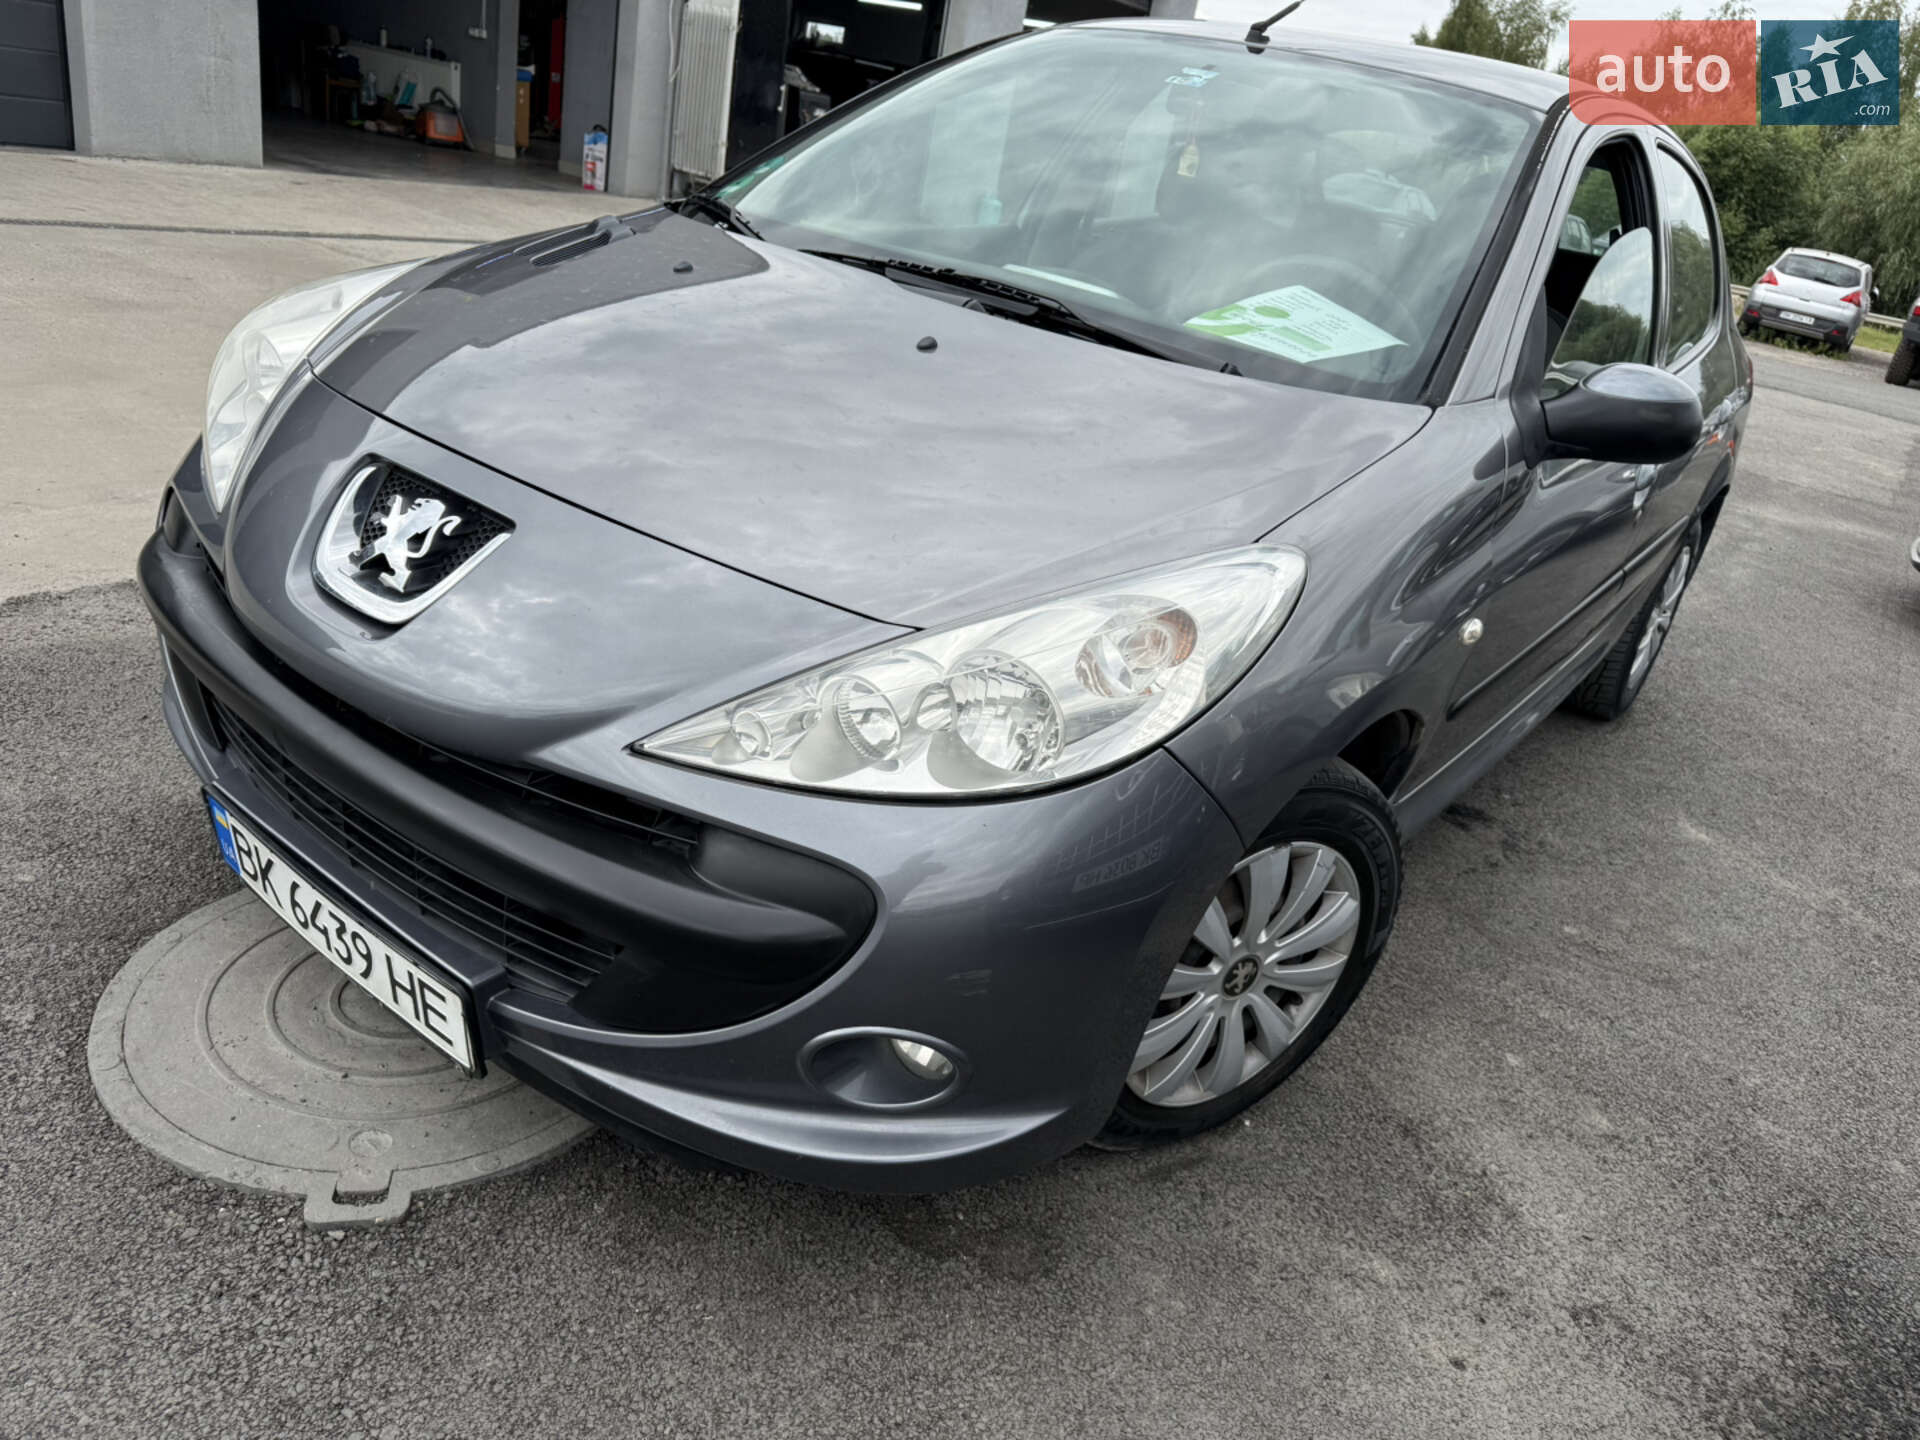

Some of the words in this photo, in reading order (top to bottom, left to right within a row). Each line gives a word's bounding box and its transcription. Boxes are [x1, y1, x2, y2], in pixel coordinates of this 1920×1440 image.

[231, 824, 284, 909] BK
[289, 880, 373, 980] 6439
[385, 952, 455, 1047] HE
